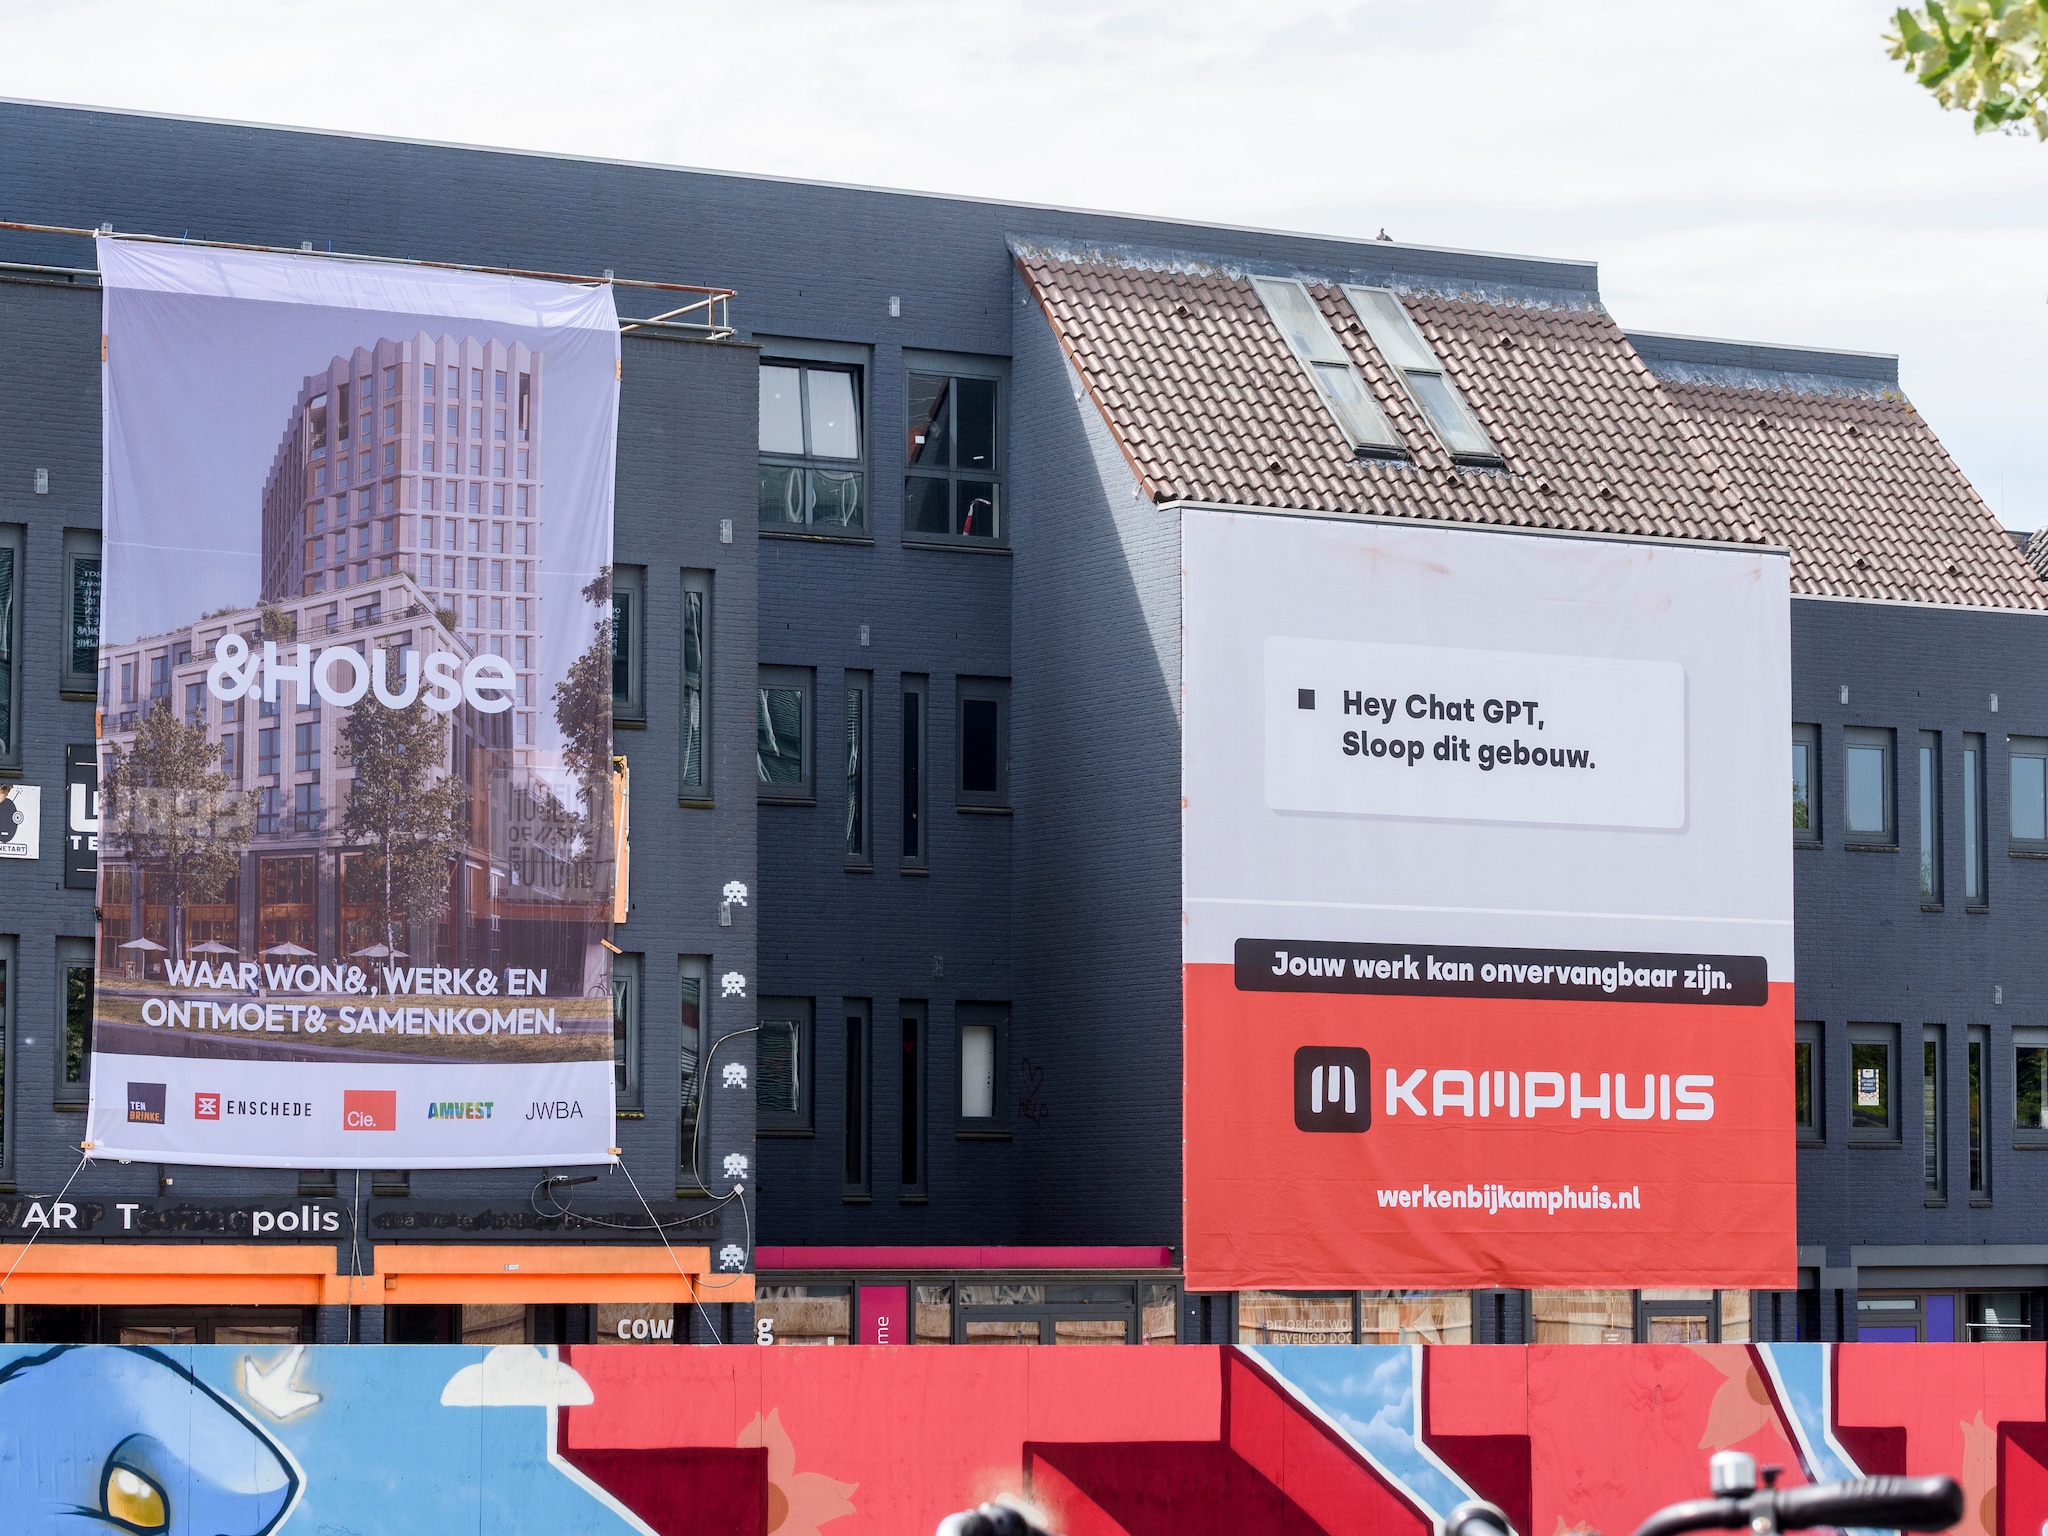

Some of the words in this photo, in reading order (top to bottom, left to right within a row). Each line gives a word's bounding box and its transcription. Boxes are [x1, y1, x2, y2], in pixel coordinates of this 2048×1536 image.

[1343, 690, 1397, 724] Hey
[1405, 693, 1475, 722] Chat
[1483, 699, 1544, 730] GPT,
[1342, 730, 1425, 766] Sloop
[1433, 735, 1471, 762] dit
[1478, 739, 1596, 771] gebouw.
[164, 958, 259, 990] WAAR
[508, 968, 548, 996] EN
[1271, 951, 1346, 977] Jouw
[1353, 954, 1420, 980] werk
[1426, 955, 1474, 982] kan
[1480, 961, 1678, 993] onvervangbaar
[1683, 964, 1733, 995] zijn.
[338, 1005, 562, 1035] SAMENKOMEN.
[1385, 1068, 1715, 1120] KAMPHUIS
[130, 1101, 146, 1111] TEN
[227, 1100, 312, 1117] ENSCHEDE
[427, 1102, 494, 1120] AMVEST
[525, 1101, 584, 1120] JWBA
[129, 1110, 163, 1122] BRINKE.
[347, 1111, 376, 1127] Cie.
[1377, 1184, 1641, 1215] werkenbijkamphuis.nl
[1286, 1319, 1325, 1330] OBJECT
[1273, 1333, 1326, 1344] BEVEILIGD
